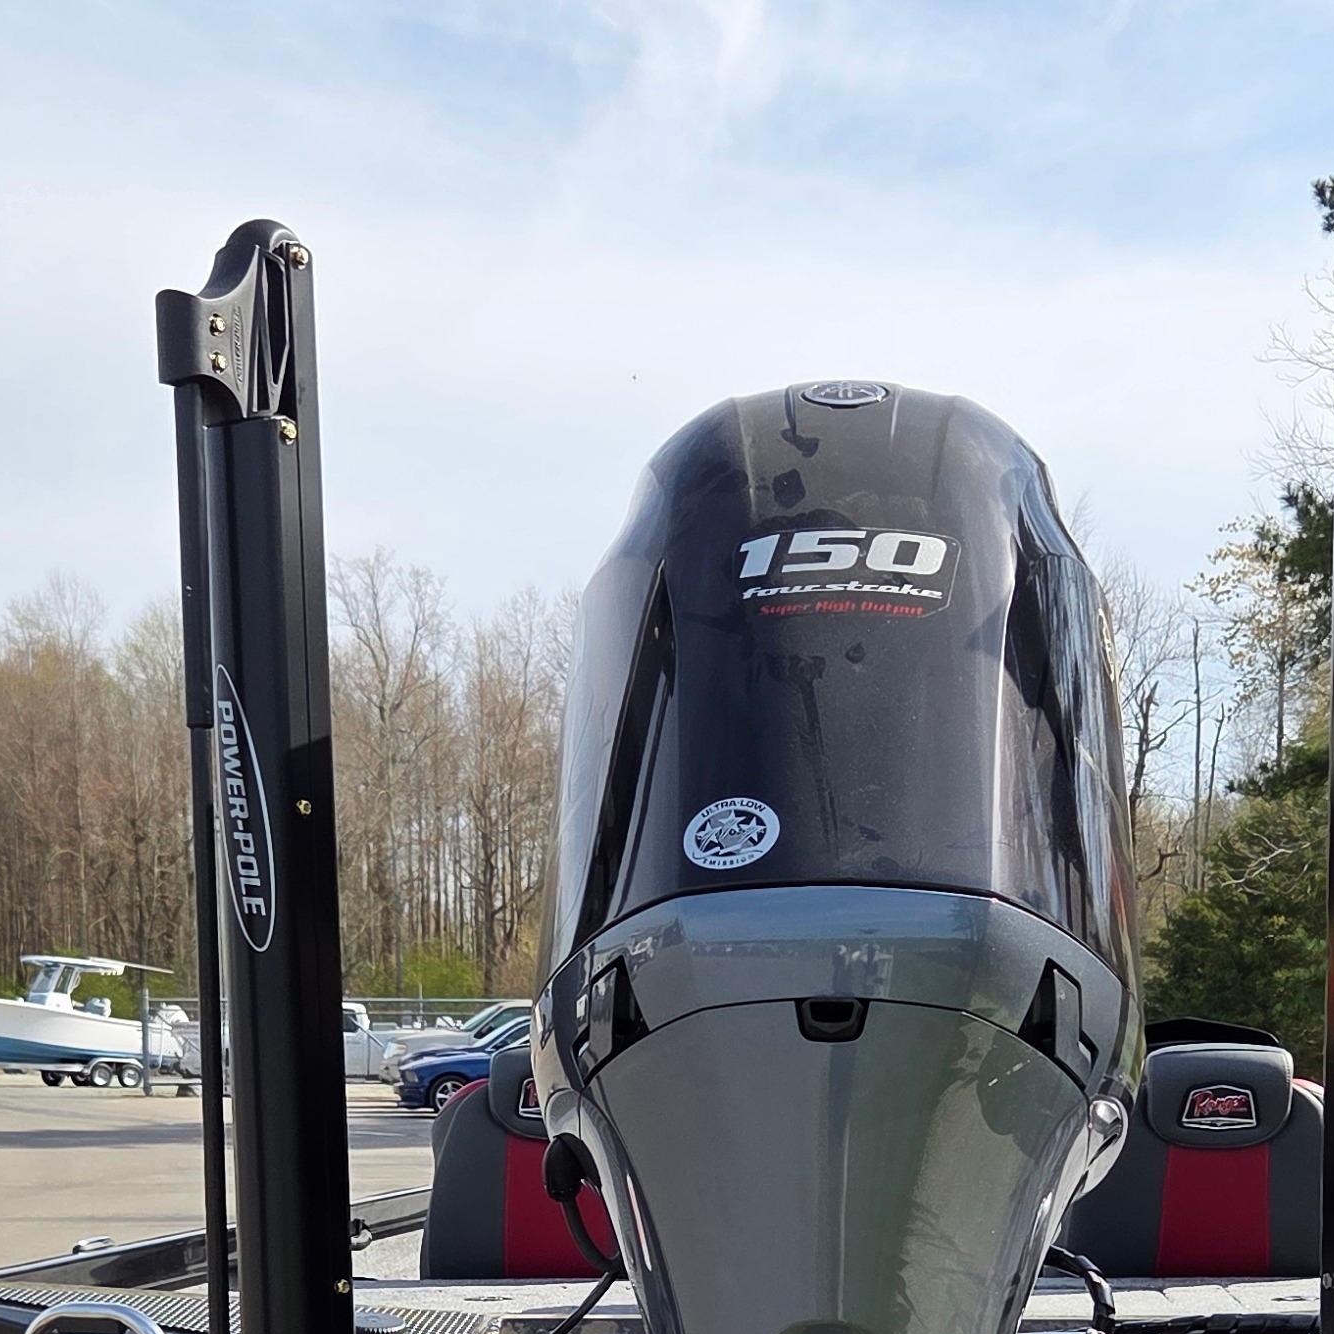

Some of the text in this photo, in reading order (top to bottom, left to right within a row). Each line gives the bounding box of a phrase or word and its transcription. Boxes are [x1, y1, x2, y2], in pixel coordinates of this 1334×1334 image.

[739, 530, 947, 578] 150
[759, 600, 924, 616] Super High Output
[218, 700, 267, 917] POWER-POLE
